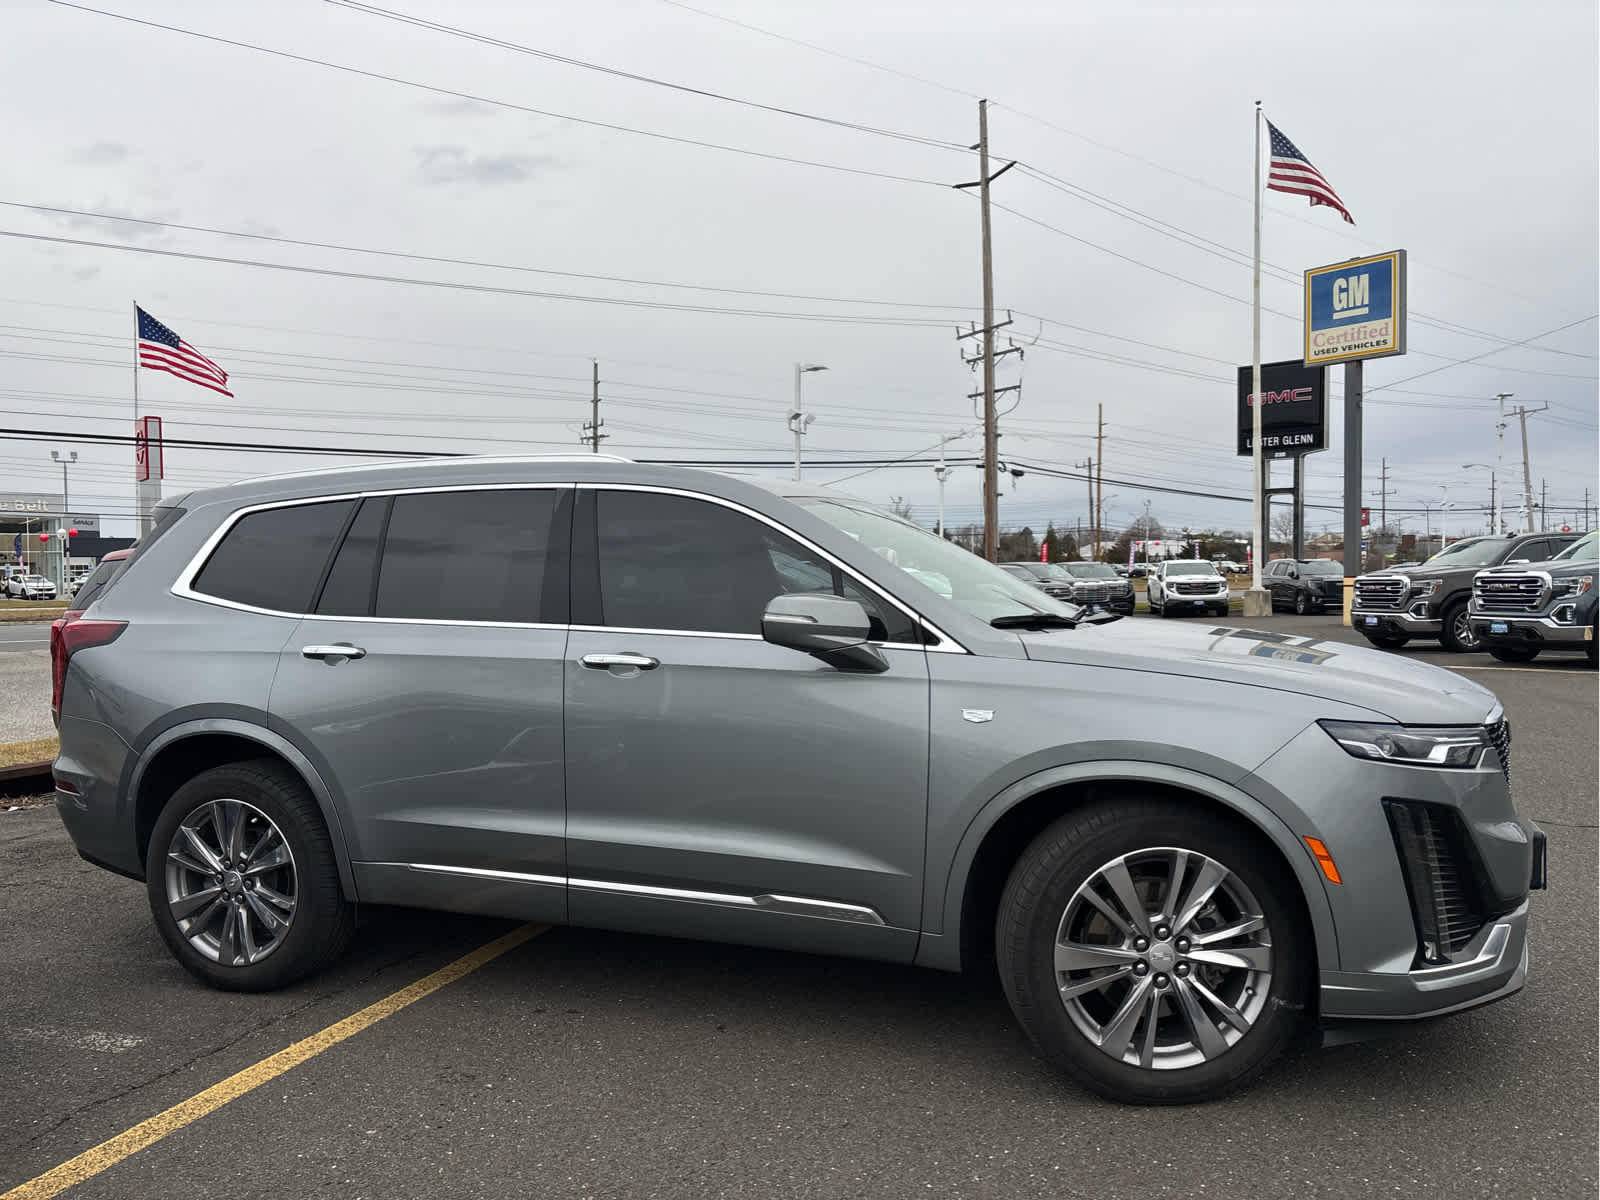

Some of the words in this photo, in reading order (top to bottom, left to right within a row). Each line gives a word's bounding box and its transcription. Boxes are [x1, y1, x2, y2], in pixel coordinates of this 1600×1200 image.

[1333, 273, 1369, 311] GM
[1313, 322, 1390, 347] Certified
[1314, 347, 1338, 356] USED
[1341, 339, 1388, 351] VEHICLES
[1247, 436, 1280, 448] LTER
[1282, 434, 1314, 445] GLENN
[15, 499, 49, 511] Belt
